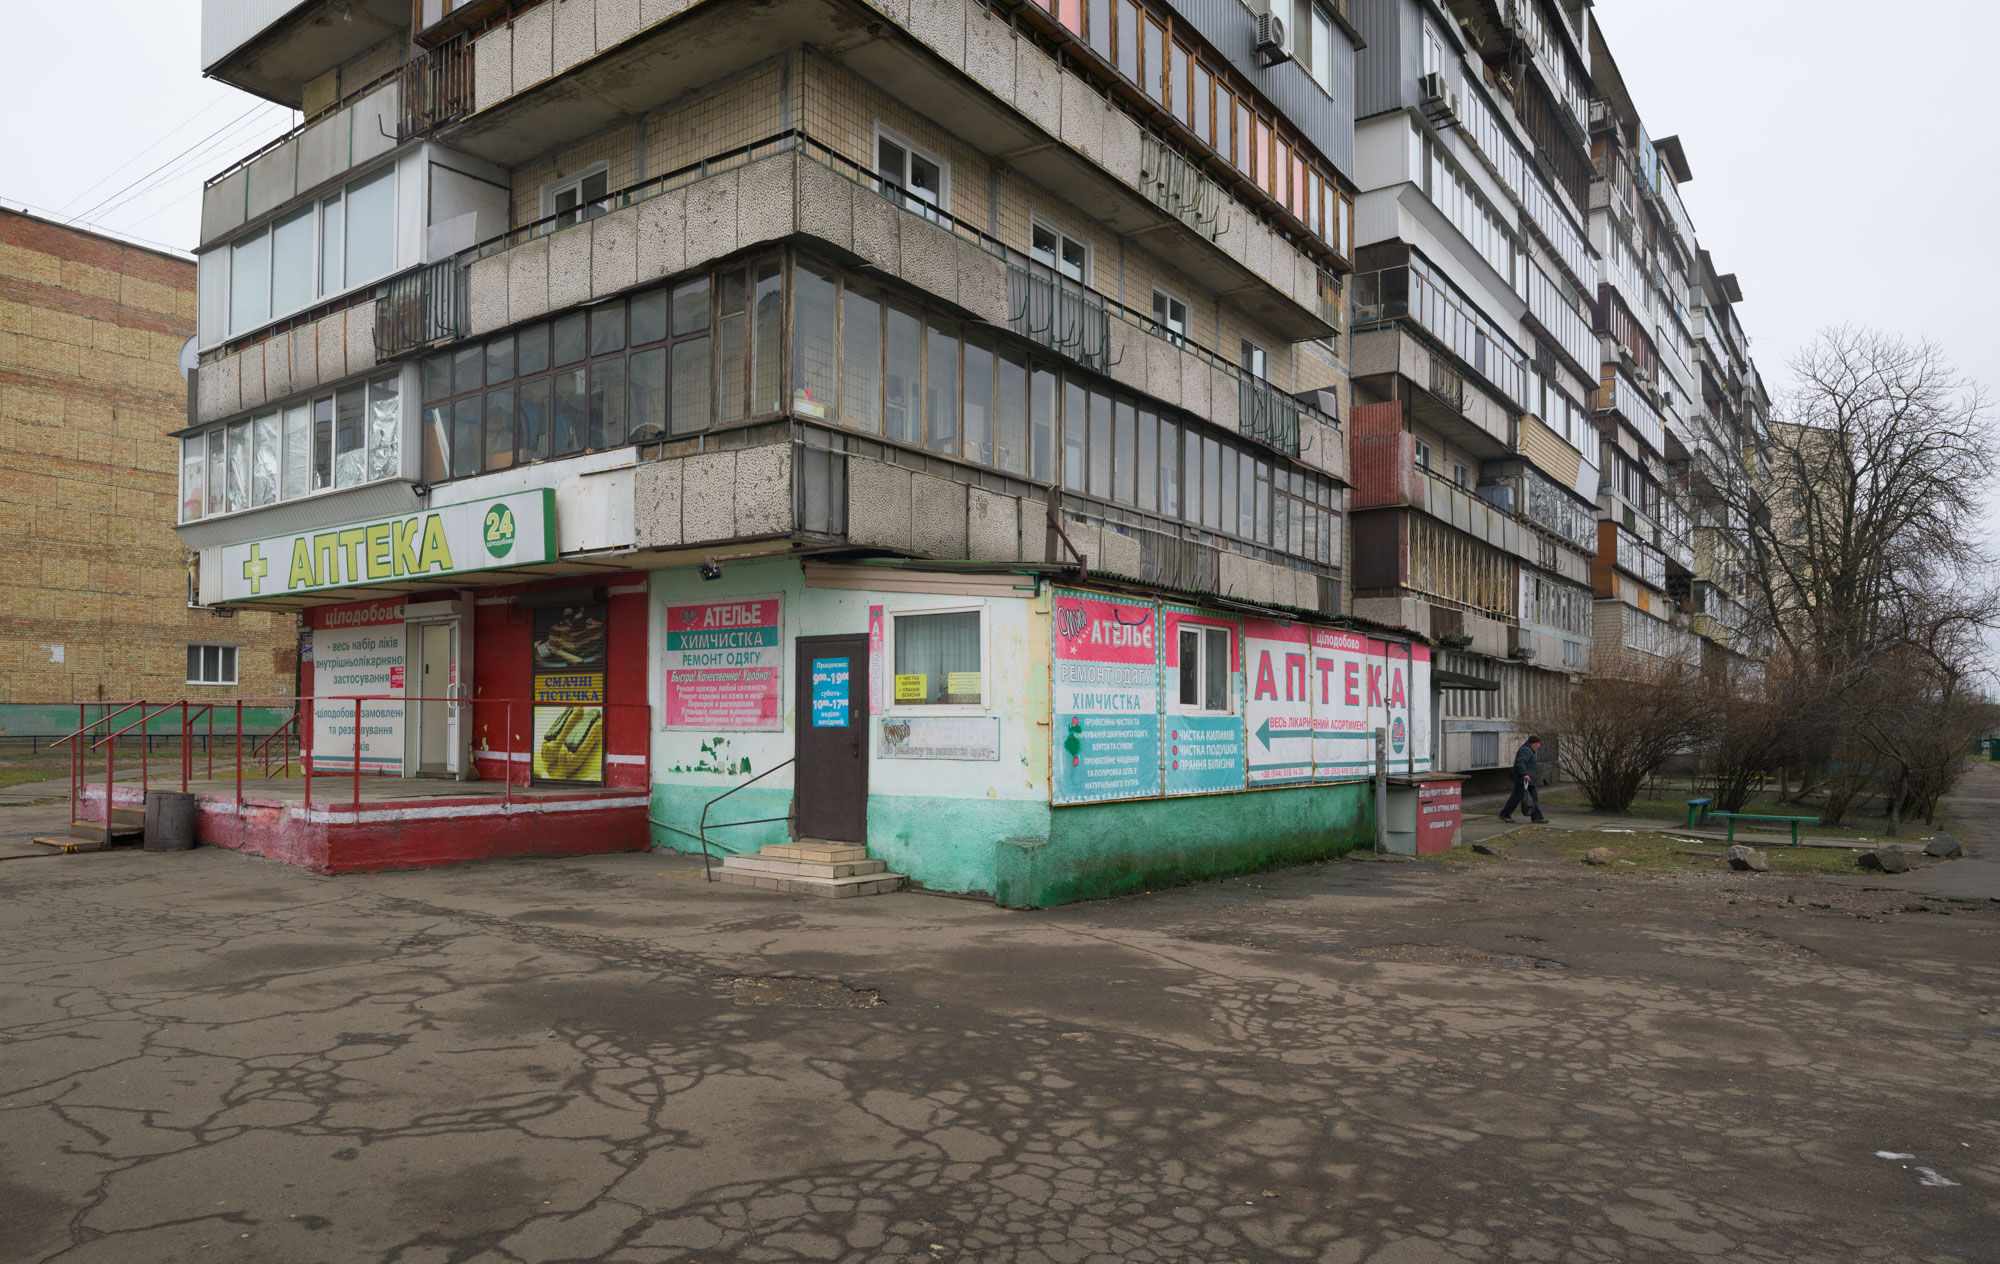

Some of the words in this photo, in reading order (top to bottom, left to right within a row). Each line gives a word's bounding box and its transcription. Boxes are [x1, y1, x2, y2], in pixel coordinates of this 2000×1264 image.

[486, 510, 513, 541] 24
[288, 513, 453, 590] АПТЕКА
[325, 604, 399, 628] цілодобов
[703, 603, 762, 627] АТЕЛЬЕ
[680, 631, 764, 649] ХИМЧИСТКА
[1090, 619, 1153, 648] АТЕЛЬЄ
[1316, 631, 1360, 650] цілодобово
[332, 642, 350, 652] весь
[352, 638, 376, 652] набір
[378, 637, 399, 649] ліків
[315, 655, 404, 671] внутрішньолікарняно
[682, 653, 723, 666] РЕМОНТ
[726, 651, 761, 667] ОДЯГУ
[333, 674, 390, 686] застосування
[545, 676, 592, 688] СМАЧНІ
[671, 671, 697, 684] Быстро!
[697, 669, 741, 683] Качественно!
[743, 667, 771, 683] Удобно!
[1061, 664, 1112, 683] РЕМОНТ
[1115, 667, 1151, 688] ОДЯГУ
[1254, 650, 1407, 709] АПТЕКА
[538, 690, 600, 702] ТІСТЕЧКА
[1072, 693, 1141, 710] ХІМЧИСТКА
[328, 726, 337, 735] та
[338, 726, 393, 737] резевування
[1269, 717, 1287, 728] ВЕСЬ
[1288, 718, 1330, 730] ЛІКАРНЯНИЙ
[1330, 720, 1367, 731] АСОРТИМЕНТ
[1393, 723, 1404, 741] 24
[1178, 730, 1205, 741] ЧИСТКА
[1205, 730, 1235, 740] КИЛИМІВ
[352, 741, 370, 752] лків
[1179, 745, 1206, 756] ЧИСТКА
[1206, 744, 1239, 757] ПОДУШОК
[1179, 760, 1207, 770] ПРАННЯ
[1207, 758, 1235, 769] БІЛИЗНИ
